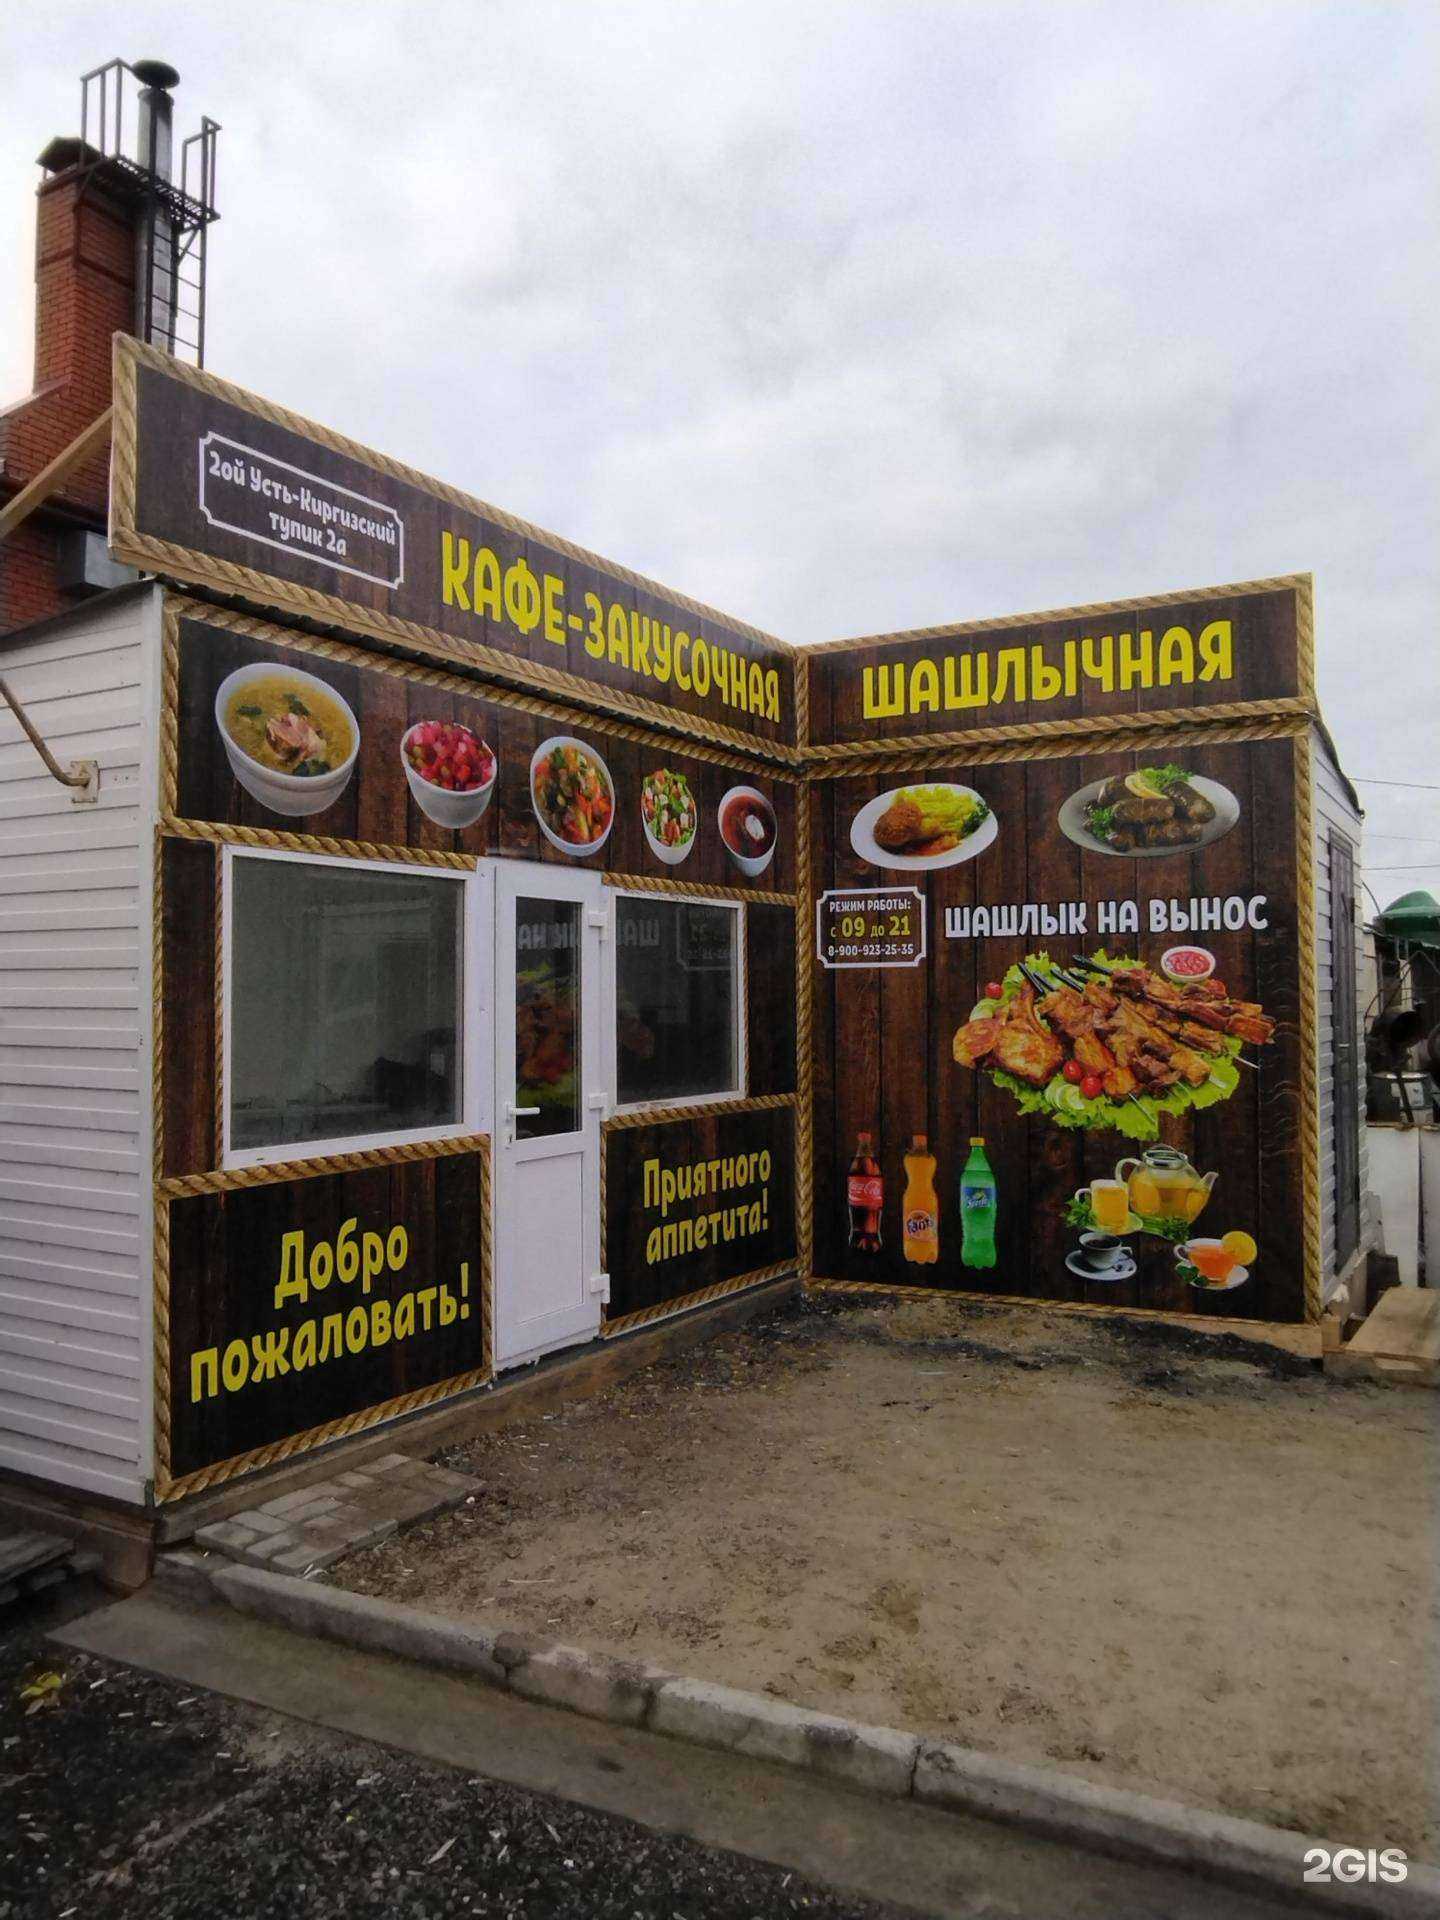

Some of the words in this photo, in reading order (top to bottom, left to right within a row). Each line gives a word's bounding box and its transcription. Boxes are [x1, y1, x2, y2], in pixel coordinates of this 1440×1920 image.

[208, 450, 246, 487] 2ой
[249, 465, 396, 546] Усть-Киргизский
[268, 511, 323, 547] тупик
[326, 528, 347, 557] 2а
[442, 530, 780, 723] КАФЕ-ЗАКУСОЧНАЯ
[862, 620, 1232, 719] ШАШЛЫЧНАЯ
[829, 900, 865, 913] РЕЖИМ
[867, 898, 912, 912] РАБОТЫ:
[841, 915, 866, 938] 09
[870, 925, 885, 938] до
[888, 914, 911, 936] 21
[945, 902, 1088, 938] ШАШЛЫК
[1097, 900, 1139, 934] НА
[1149, 895, 1269, 933] ВЫНОС
[828, 943, 914, 957] 8-900-923-25-35
[643, 1149, 771, 1218] Приятного
[646, 1186, 769, 1266] аппетита!
[274, 1217, 408, 1310] Добро
[190, 1262, 470, 1403] пожаловать!
